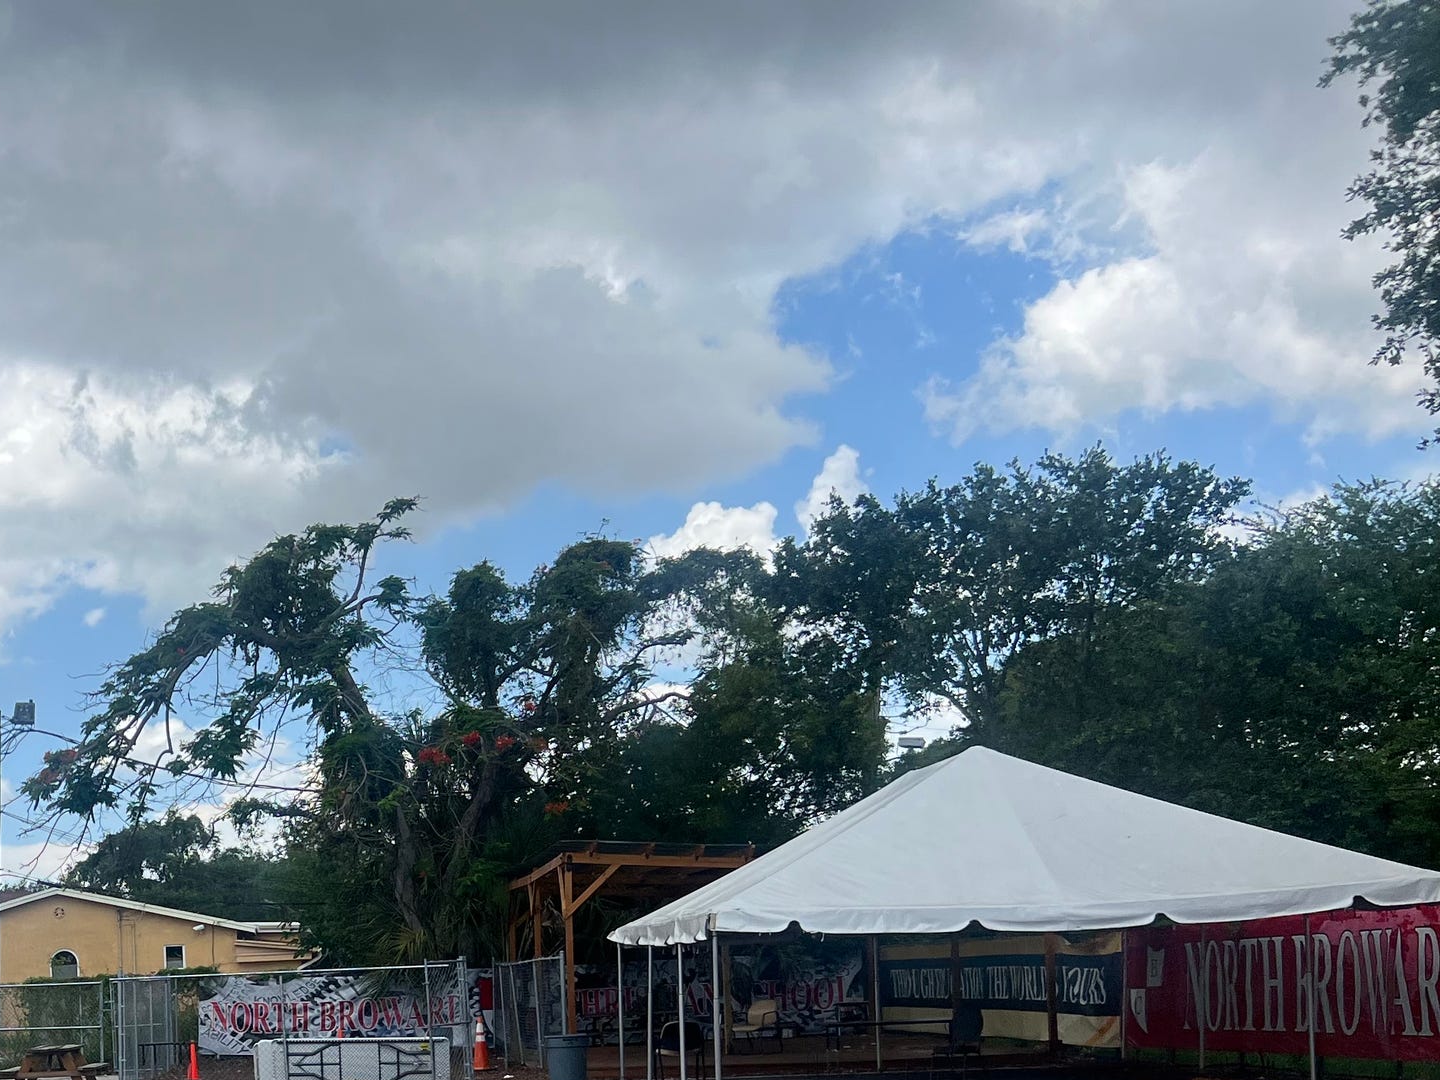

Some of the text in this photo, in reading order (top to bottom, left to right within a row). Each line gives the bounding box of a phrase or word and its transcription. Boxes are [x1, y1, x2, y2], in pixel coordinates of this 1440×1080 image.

[750, 975, 845, 1011] HOOL
[986, 965, 1009, 999] THE
[1184, 935, 1285, 1033] NORTH
[210, 1000, 311, 1034] NORTH
